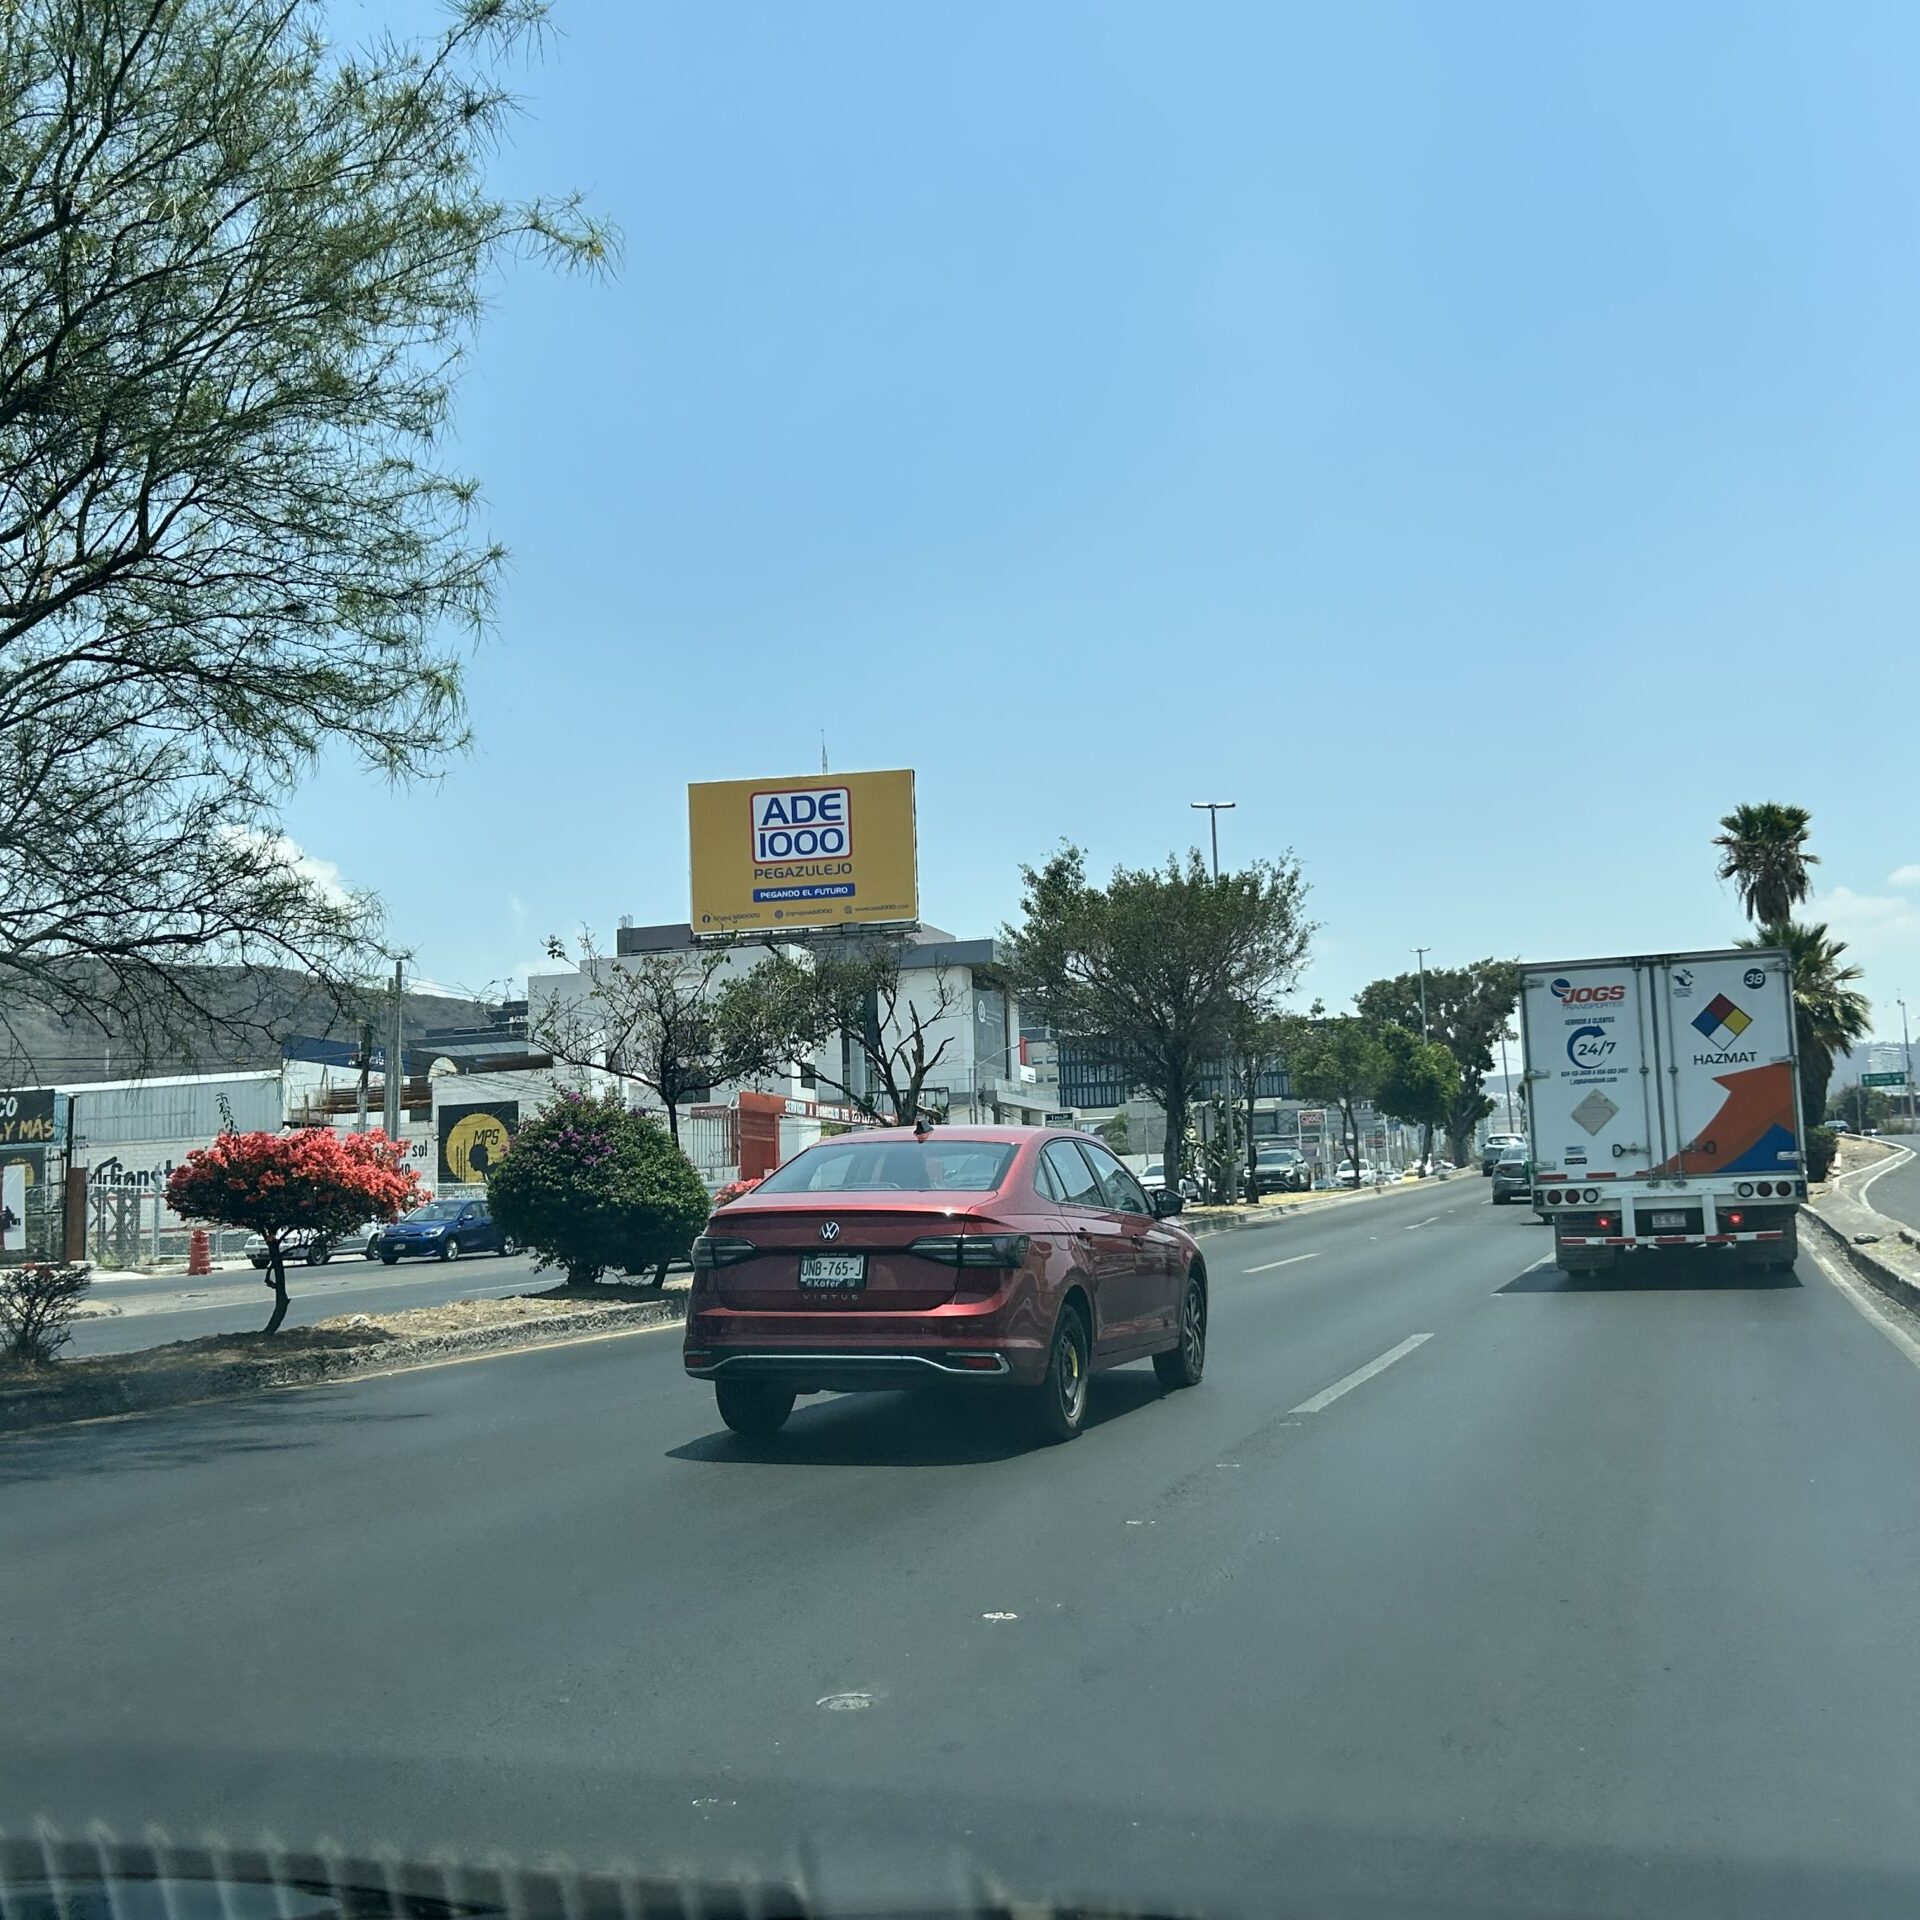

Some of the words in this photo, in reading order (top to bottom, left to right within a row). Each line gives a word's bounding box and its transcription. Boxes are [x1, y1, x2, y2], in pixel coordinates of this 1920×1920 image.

[761, 793, 841, 826] ADE
[760, 828, 844, 858] 1000
[754, 863, 853, 881] PEGAZULEJO
[760, 890, 800, 899] PEGANDO
[814, 886, 848, 896] FUTURO
[1746, 973, 1763, 985] 38
[1561, 985, 1625, 1004] JOGS
[1577, 1040, 1616, 1056] 24/7
[1693, 1052, 1757, 1065] HAZMAT
[809, 1104, 813, 1116] A
[18, 1113, 54, 1141] MÁS
[474, 1129, 500, 1146] MPS
[412, 1140, 428, 1157] sol
[801, 1260, 862, 1277] UNB-765-J
